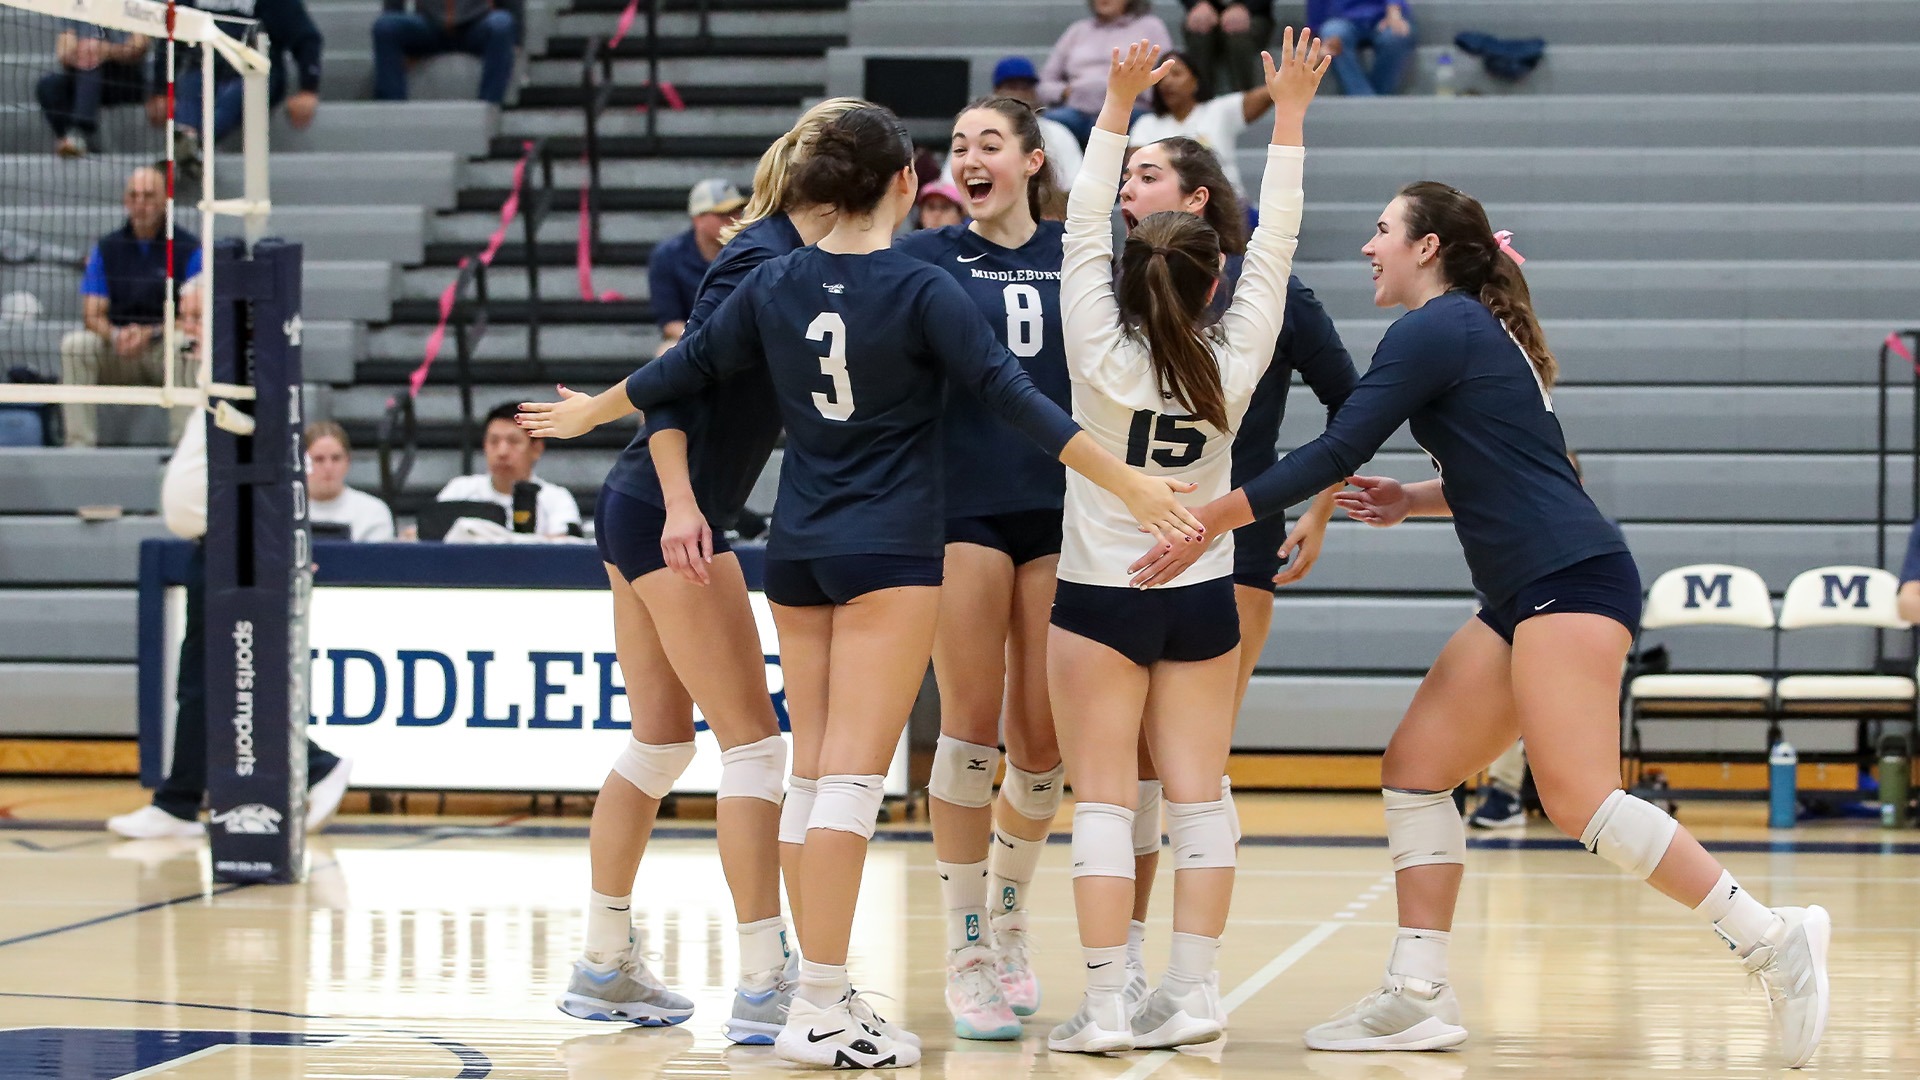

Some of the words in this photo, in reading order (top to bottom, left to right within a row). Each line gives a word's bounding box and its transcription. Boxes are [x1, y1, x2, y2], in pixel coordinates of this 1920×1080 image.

[971, 268, 1061, 282] MIDDLEBURY
[1003, 283, 1043, 357] 8
[805, 312, 855, 421] 3
[1126, 408, 1207, 467] 15
[1683, 574, 1732, 608] M
[1821, 574, 1870, 608] M
[232, 620, 256, 690] sports
[231, 691, 257, 776] imports
